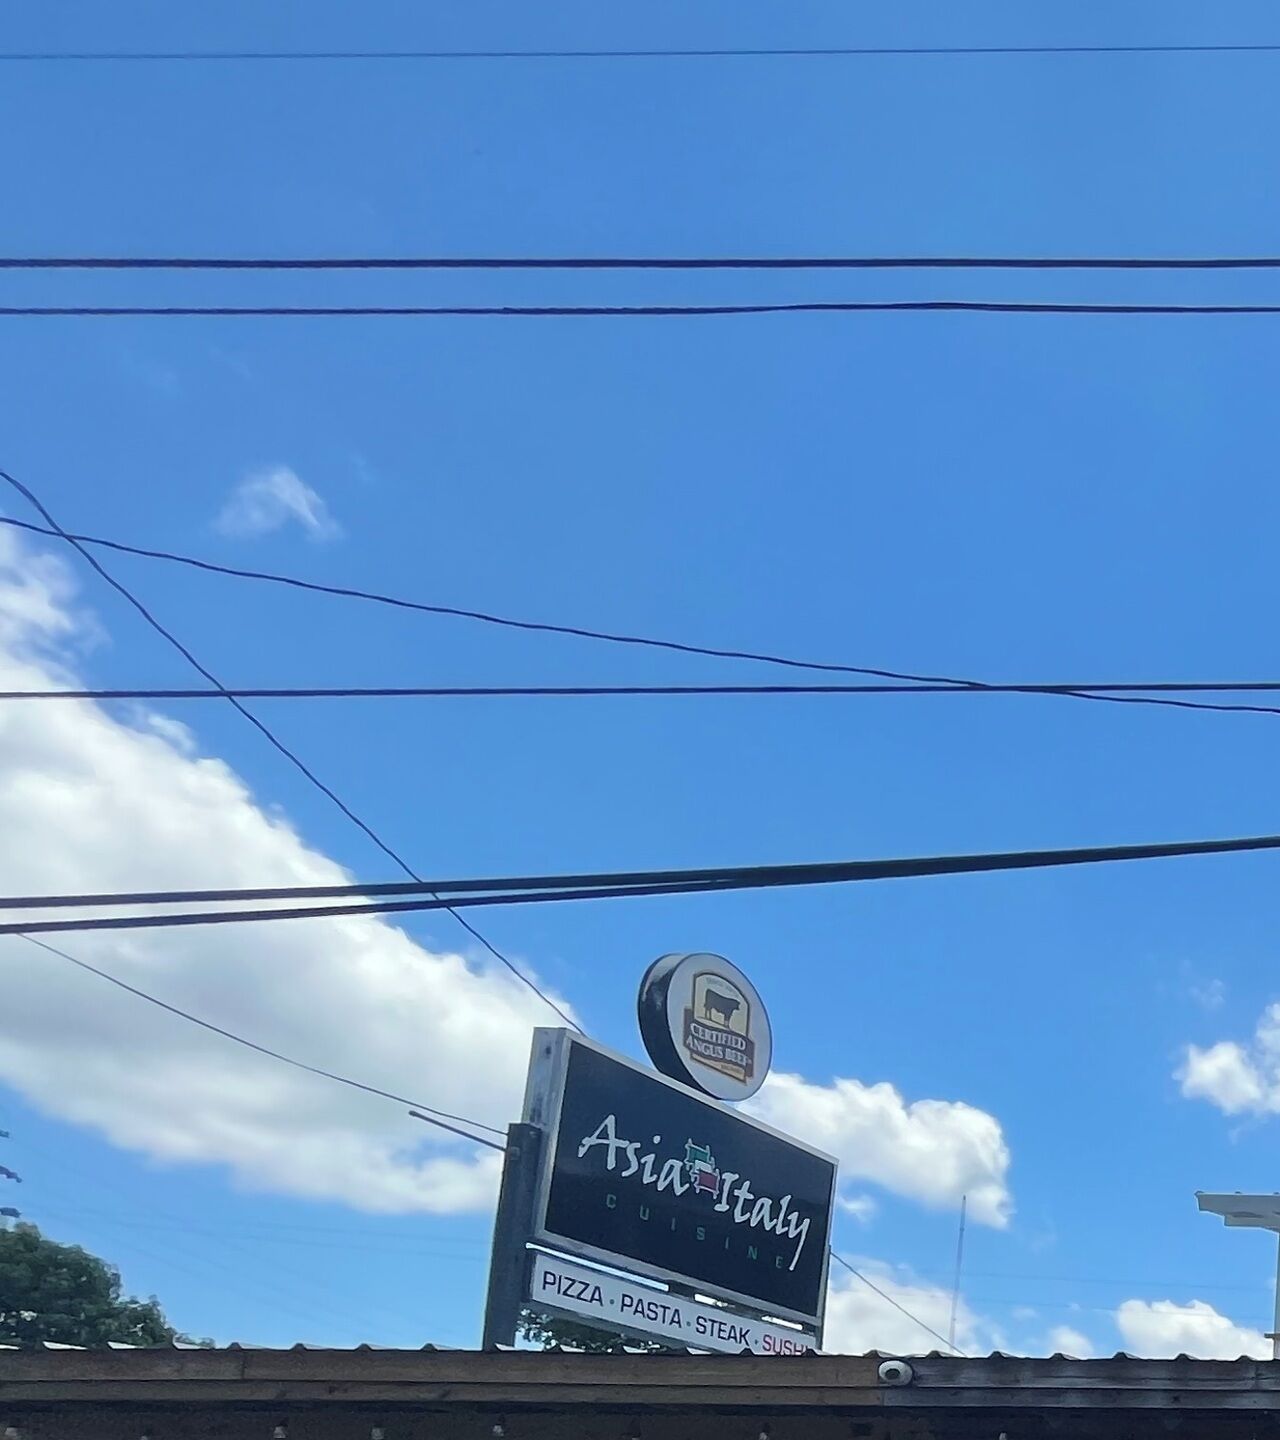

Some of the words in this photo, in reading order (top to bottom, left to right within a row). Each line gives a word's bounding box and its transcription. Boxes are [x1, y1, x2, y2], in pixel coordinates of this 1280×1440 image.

[686, 1035, 724, 1059] ANGUS
[690, 1023, 746, 1050] CERTIFIED
[578, 1114, 690, 1196] Asia
[713, 1171, 810, 1271] Italy
[605, 1193, 784, 1269] CUISINE
[542, 1270, 604, 1307] PIZZA
[620, 1293, 682, 1329] PASTA
[695, 1315, 751, 1346] STEAK
[762, 1334, 808, 1355] SUSH
